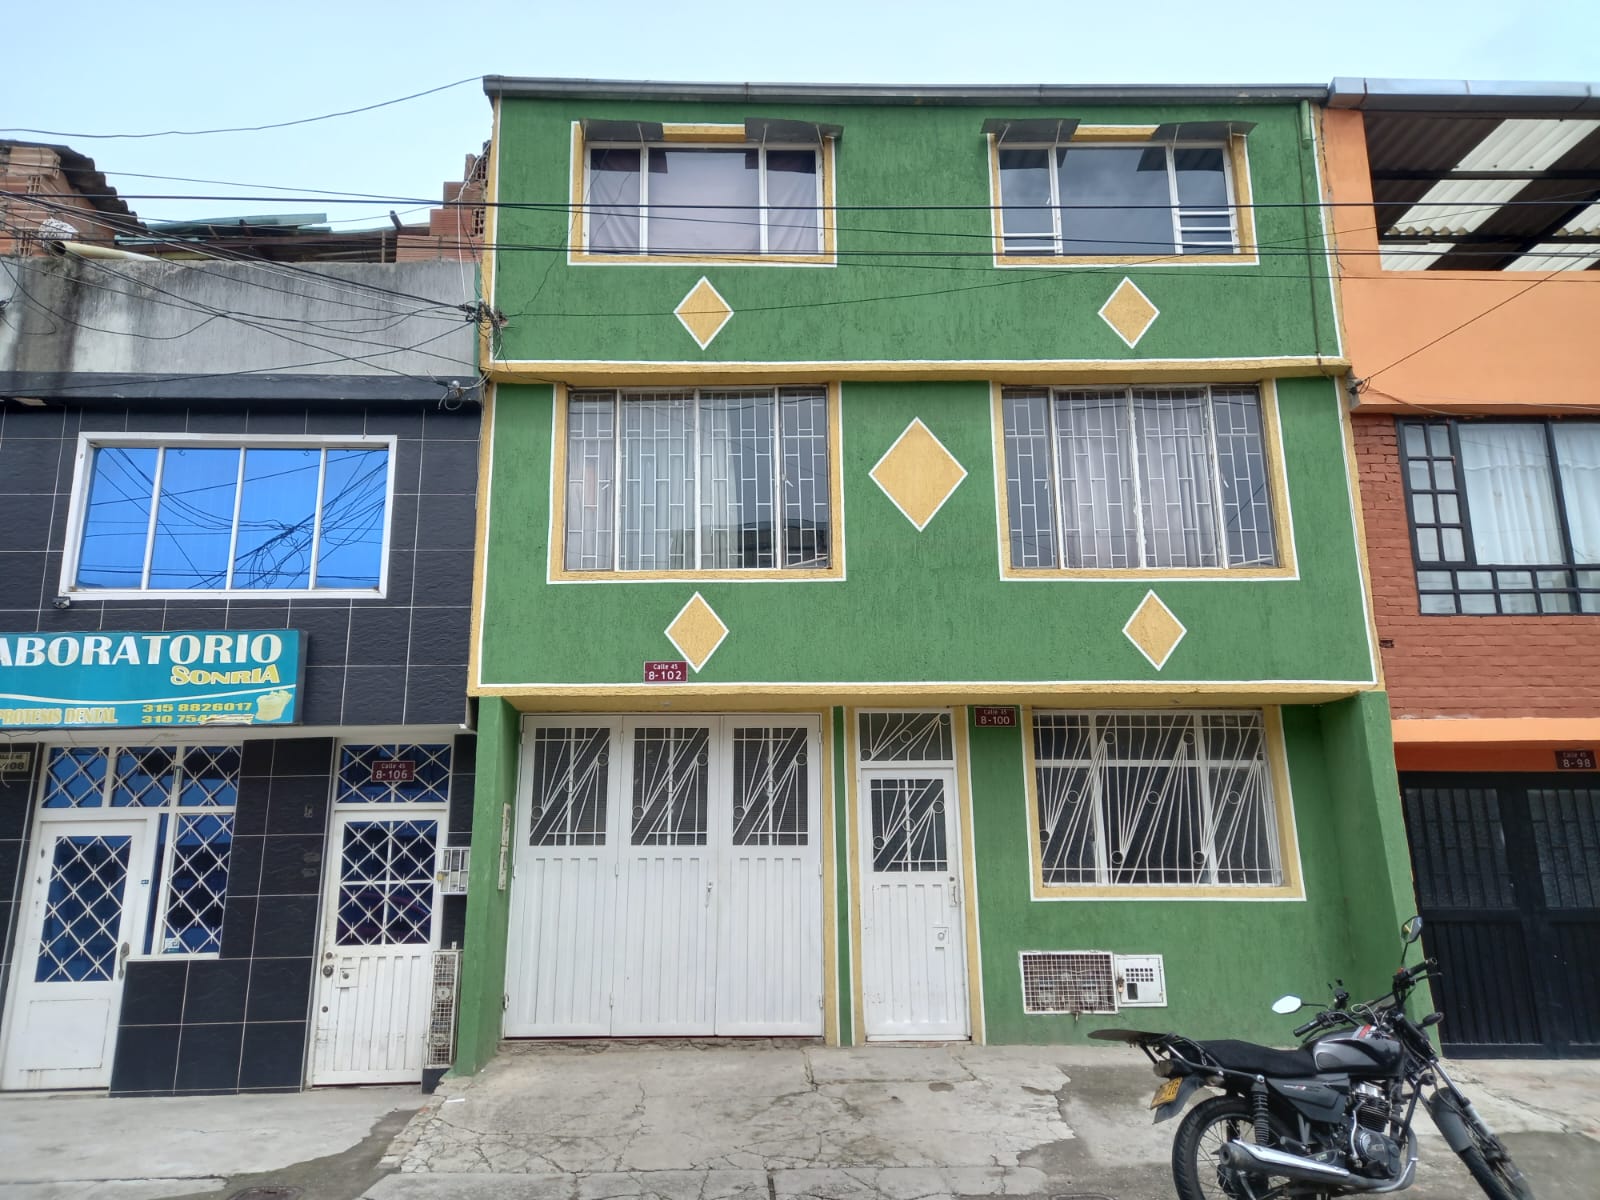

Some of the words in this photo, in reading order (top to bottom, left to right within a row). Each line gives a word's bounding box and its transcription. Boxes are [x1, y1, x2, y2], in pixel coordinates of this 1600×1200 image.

[648, 671, 682, 680] 8-102
[142, 703, 174, 712] 315
[178, 702, 252, 712] 8826017
[142, 715, 173, 723] 310
[980, 715, 1010, 725] 8-100
[1563, 758, 1591, 768] 8-98
[375, 769, 409, 780] 8-106
